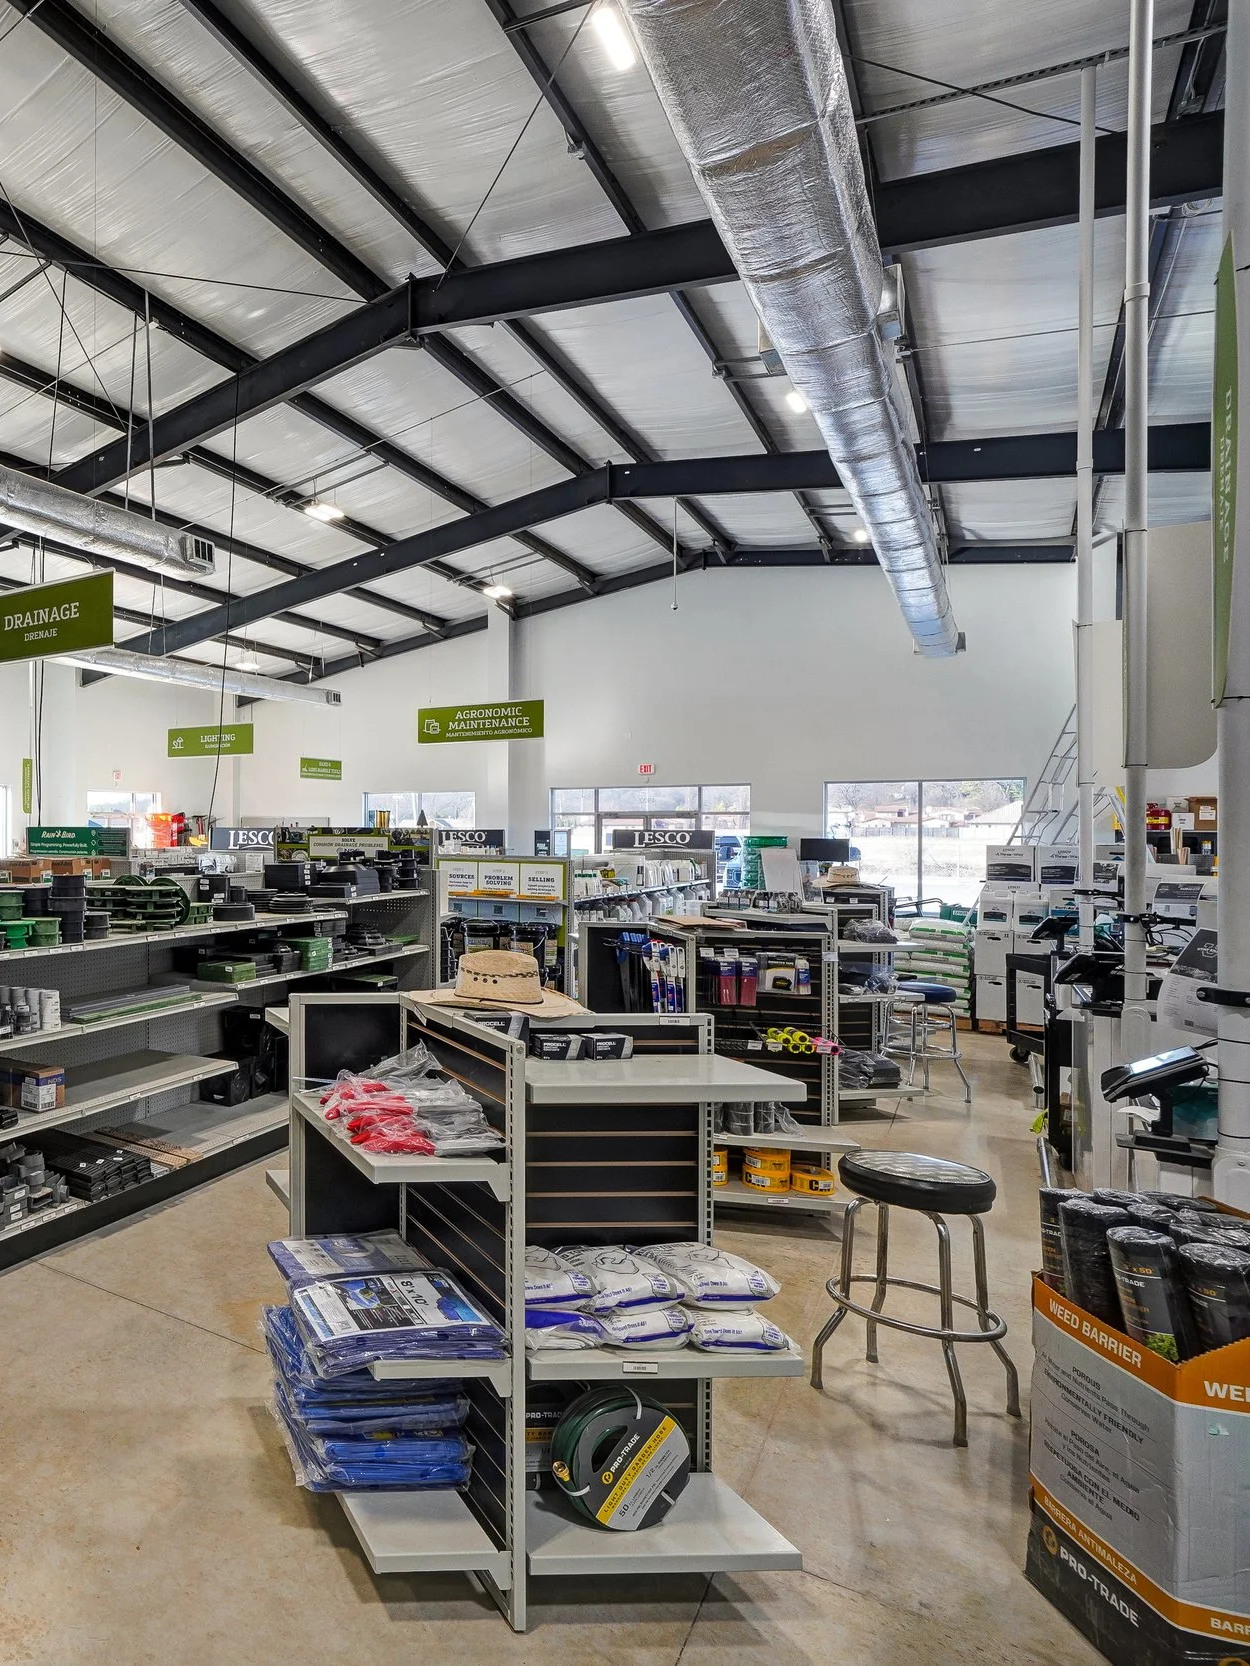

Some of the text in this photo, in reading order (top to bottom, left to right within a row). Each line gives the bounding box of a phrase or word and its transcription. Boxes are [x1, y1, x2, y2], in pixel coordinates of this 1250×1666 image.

[1223, 385, 1232, 564] DRAINAGE
[4, 602, 80, 631] DRAINAGE
[24, 628, 58, 641] DRENAJE
[448, 717, 530, 730] MAINTENANCE
[455, 706, 523, 720] AGRONOMIC
[639, 764, 652, 773] EXIT
[41, 830, 76, 838] RAIN BIRD
[633, 831, 691, 848] LESCO
[1049, 1297, 1143, 1369] WEED BARRIER
[1072, 1366, 1101, 1391] POROUS
[1044, 1368, 1144, 1445] ENVIRONMENTALLY FRIENDLY
[1060, 1392, 1112, 1434] Conserves Water
[1061, 1369, 1071, 1380] and
[1073, 1376, 1101, 1401] Nutrients
[1102, 1396, 1119, 1413] Pass
[1120, 1408, 1150, 1433] Through
[611, 1433, 640, 1473] PRO-TRADE
[1070, 1429, 1100, 1457] POROSA
[604, 1492, 619, 1513] LIGHT
[619, 1473, 632, 1491] DUTY
[632, 1445, 652, 1471] GARDEN
[652, 1426, 667, 1446] HOSE
[1044, 1439, 1140, 1521] RESPETUOSA CON EL MEDIO
[1069, 1438, 1084, 1454] Paso
[1120, 1475, 1140, 1494] Agua
[1076, 1453, 1111, 1483] Nutrientes
[1067, 1470, 1104, 1504] AMBIENTE
[618, 1503, 630, 1517] 50
[1095, 1502, 1113, 1521] Agua
[1044, 1495, 1138, 1586] BARRERA ANTIMALEZA
[1060, 1546, 1140, 1628] PRO-TRADE
